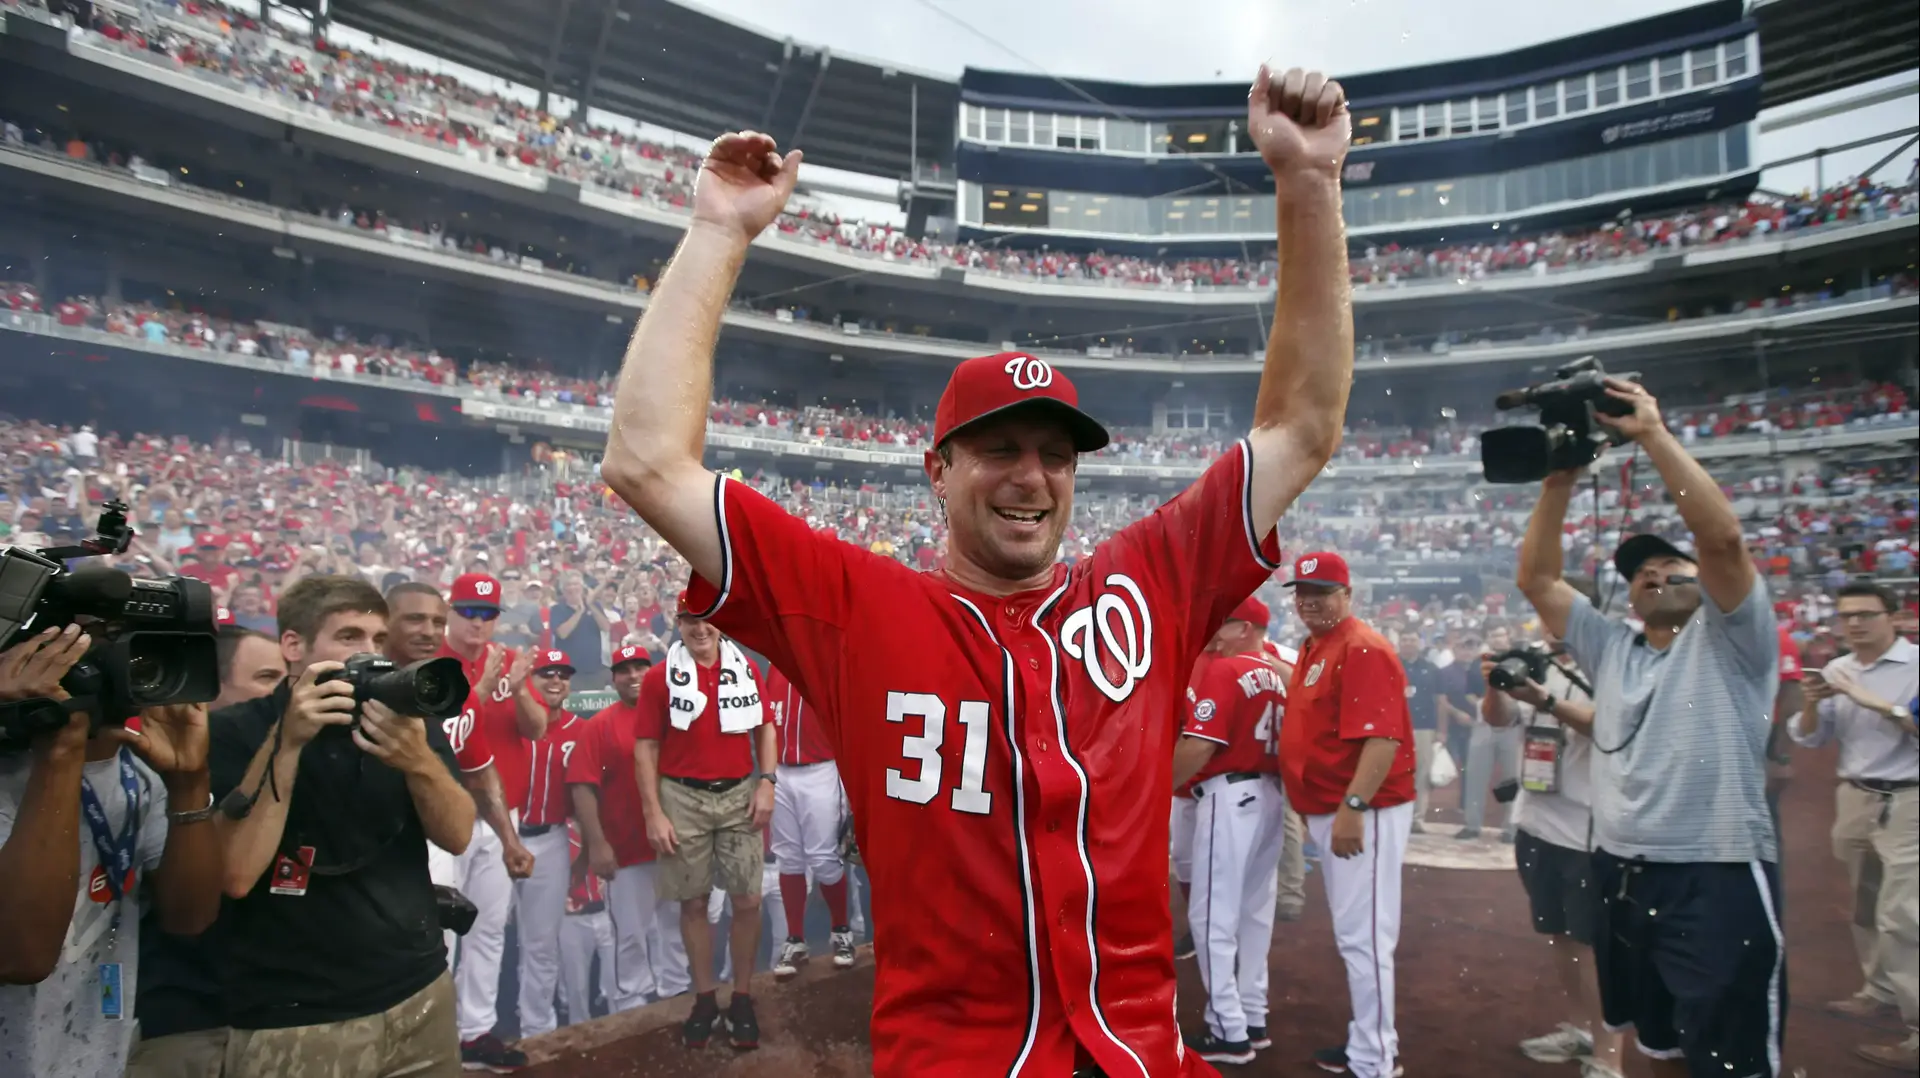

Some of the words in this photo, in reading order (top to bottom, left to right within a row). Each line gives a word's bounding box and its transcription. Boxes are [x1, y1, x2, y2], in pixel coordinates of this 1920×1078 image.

[1004, 356, 1053, 390] W
[1060, 573, 1153, 703] W
[886, 690, 993, 815] 31
